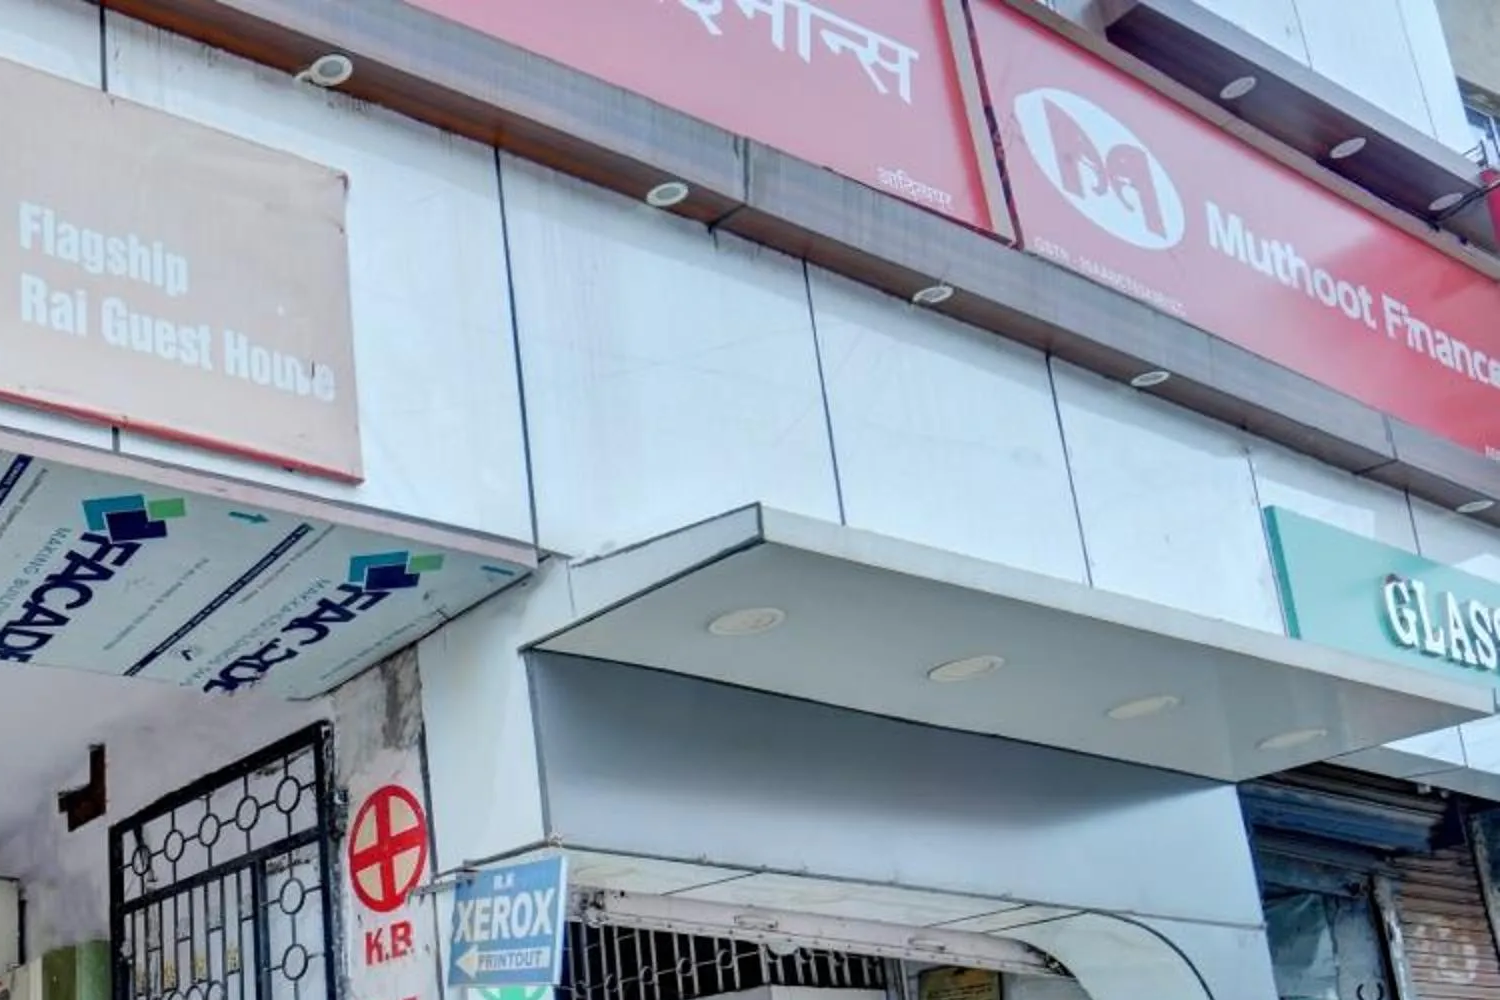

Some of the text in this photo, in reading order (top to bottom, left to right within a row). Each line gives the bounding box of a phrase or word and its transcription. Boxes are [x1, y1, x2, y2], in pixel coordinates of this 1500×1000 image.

[19, 201, 188, 297] Flagship
[1206, 200, 1377, 330] Muthoot
[21, 273, 87, 337] Rai
[102, 296, 212, 371] Guest
[1384, 575, 1500, 670] GLAS
[454, 887, 555, 943] XEROX
[479, 949, 543, 969] PRINTOUT
